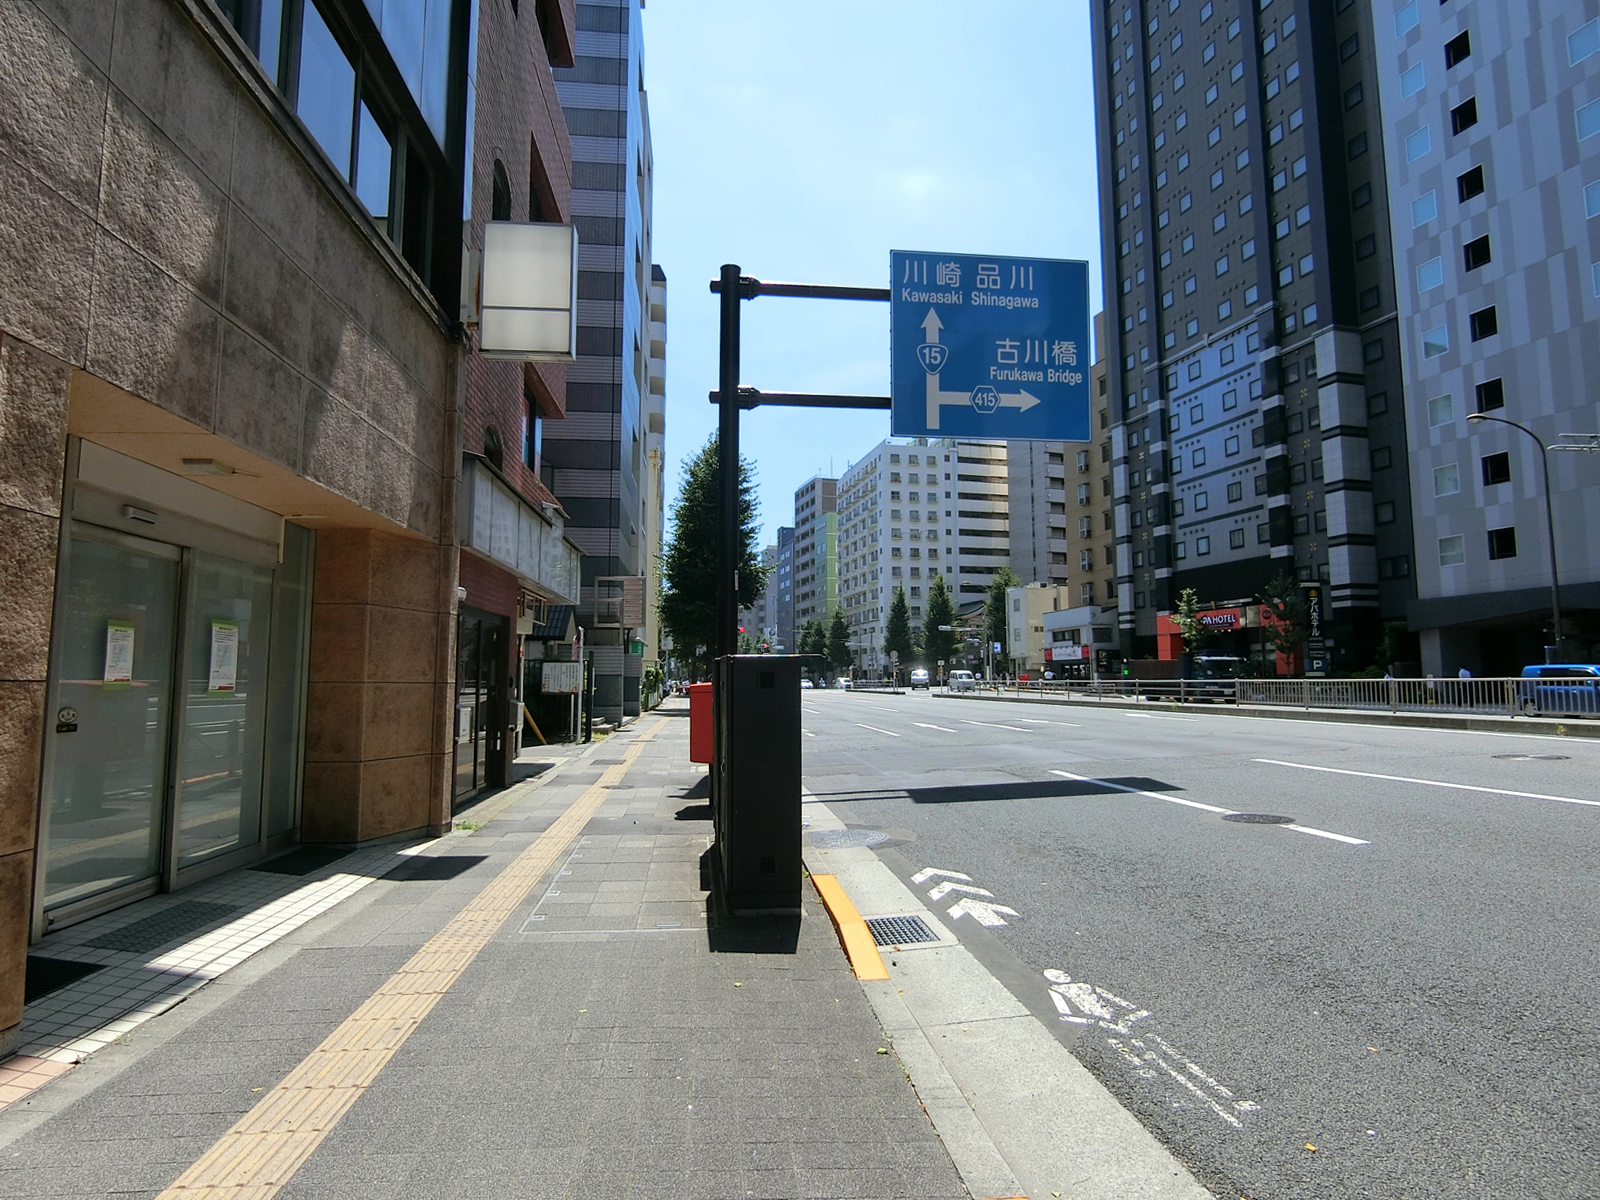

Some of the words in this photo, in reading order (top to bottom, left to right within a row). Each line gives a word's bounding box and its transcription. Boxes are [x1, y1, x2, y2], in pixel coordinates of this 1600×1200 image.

[903, 260, 962, 288] 川崎
[976, 263, 1034, 291] 品川
[902, 288, 963, 305] Kawasaki
[971, 291, 1039, 309] Shinagawa
[922, 347, 941, 365] 15
[995, 338, 1077, 366] 古川橋
[989, 366, 1044, 382] Furukawa
[1047, 368, 1083, 386] Bridge
[974, 393, 995, 407] 415
[1212, 614, 1236, 624] HOTEL
[1313, 660, 1322, 670] P
